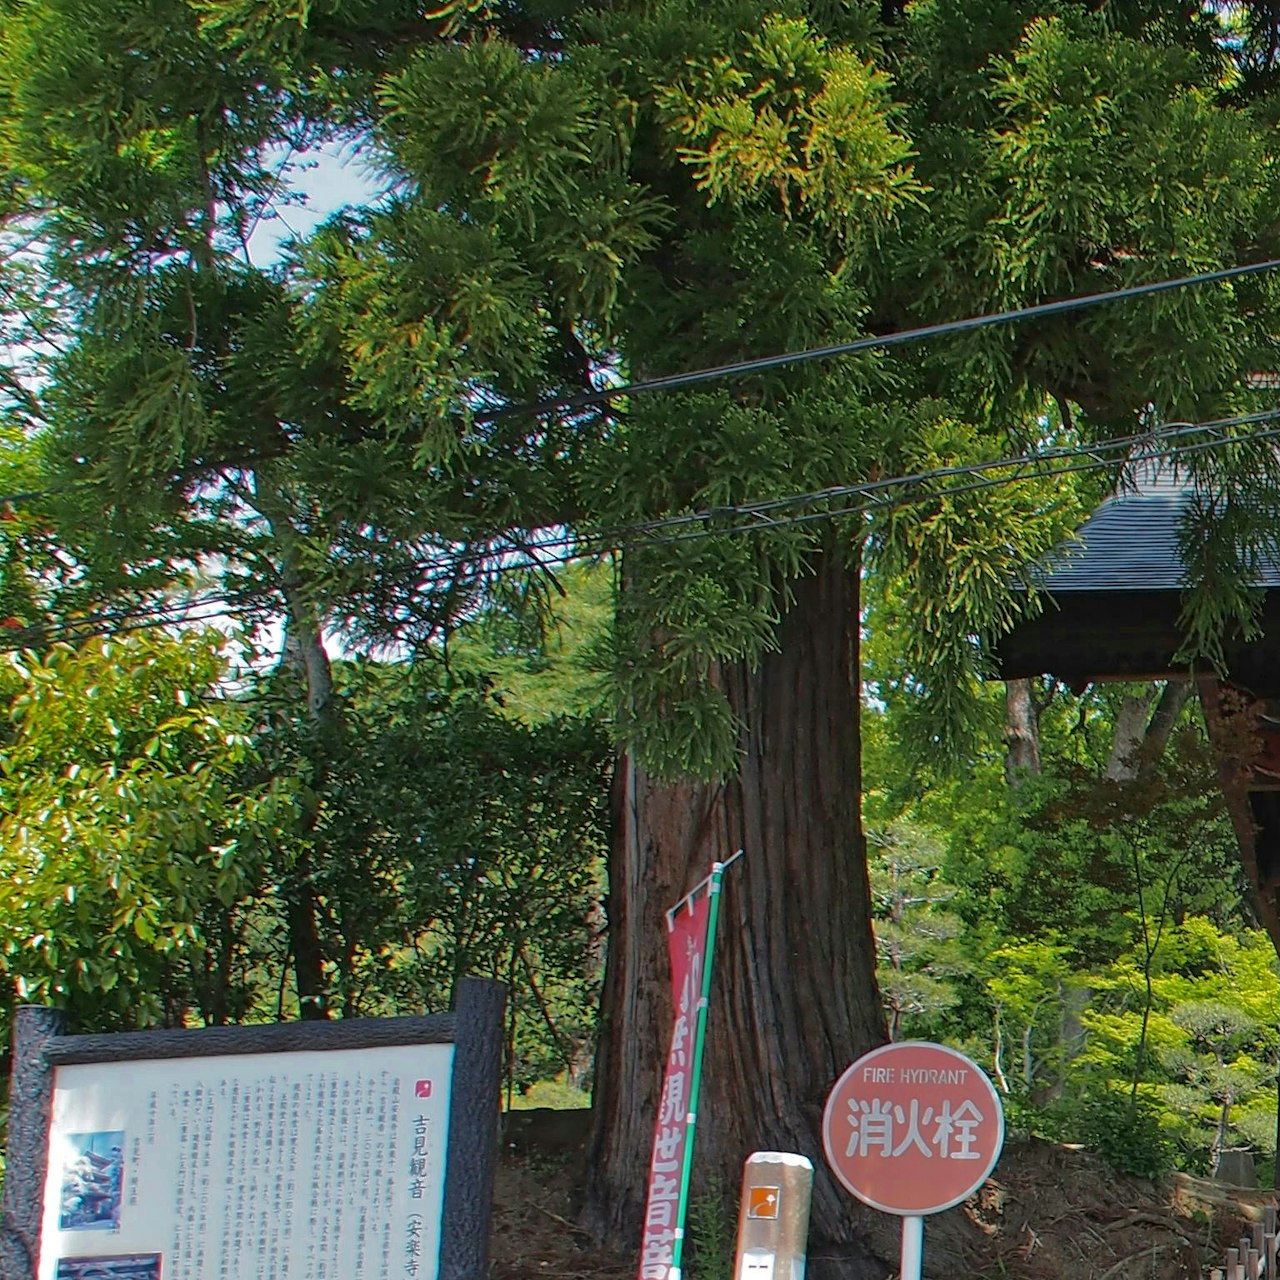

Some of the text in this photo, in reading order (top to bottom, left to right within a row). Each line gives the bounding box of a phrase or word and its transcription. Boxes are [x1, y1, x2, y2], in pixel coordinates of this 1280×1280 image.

[863, 1067, 968, 1085] FIRE HYDRANT
[845, 1097, 984, 1160] 消火栓
